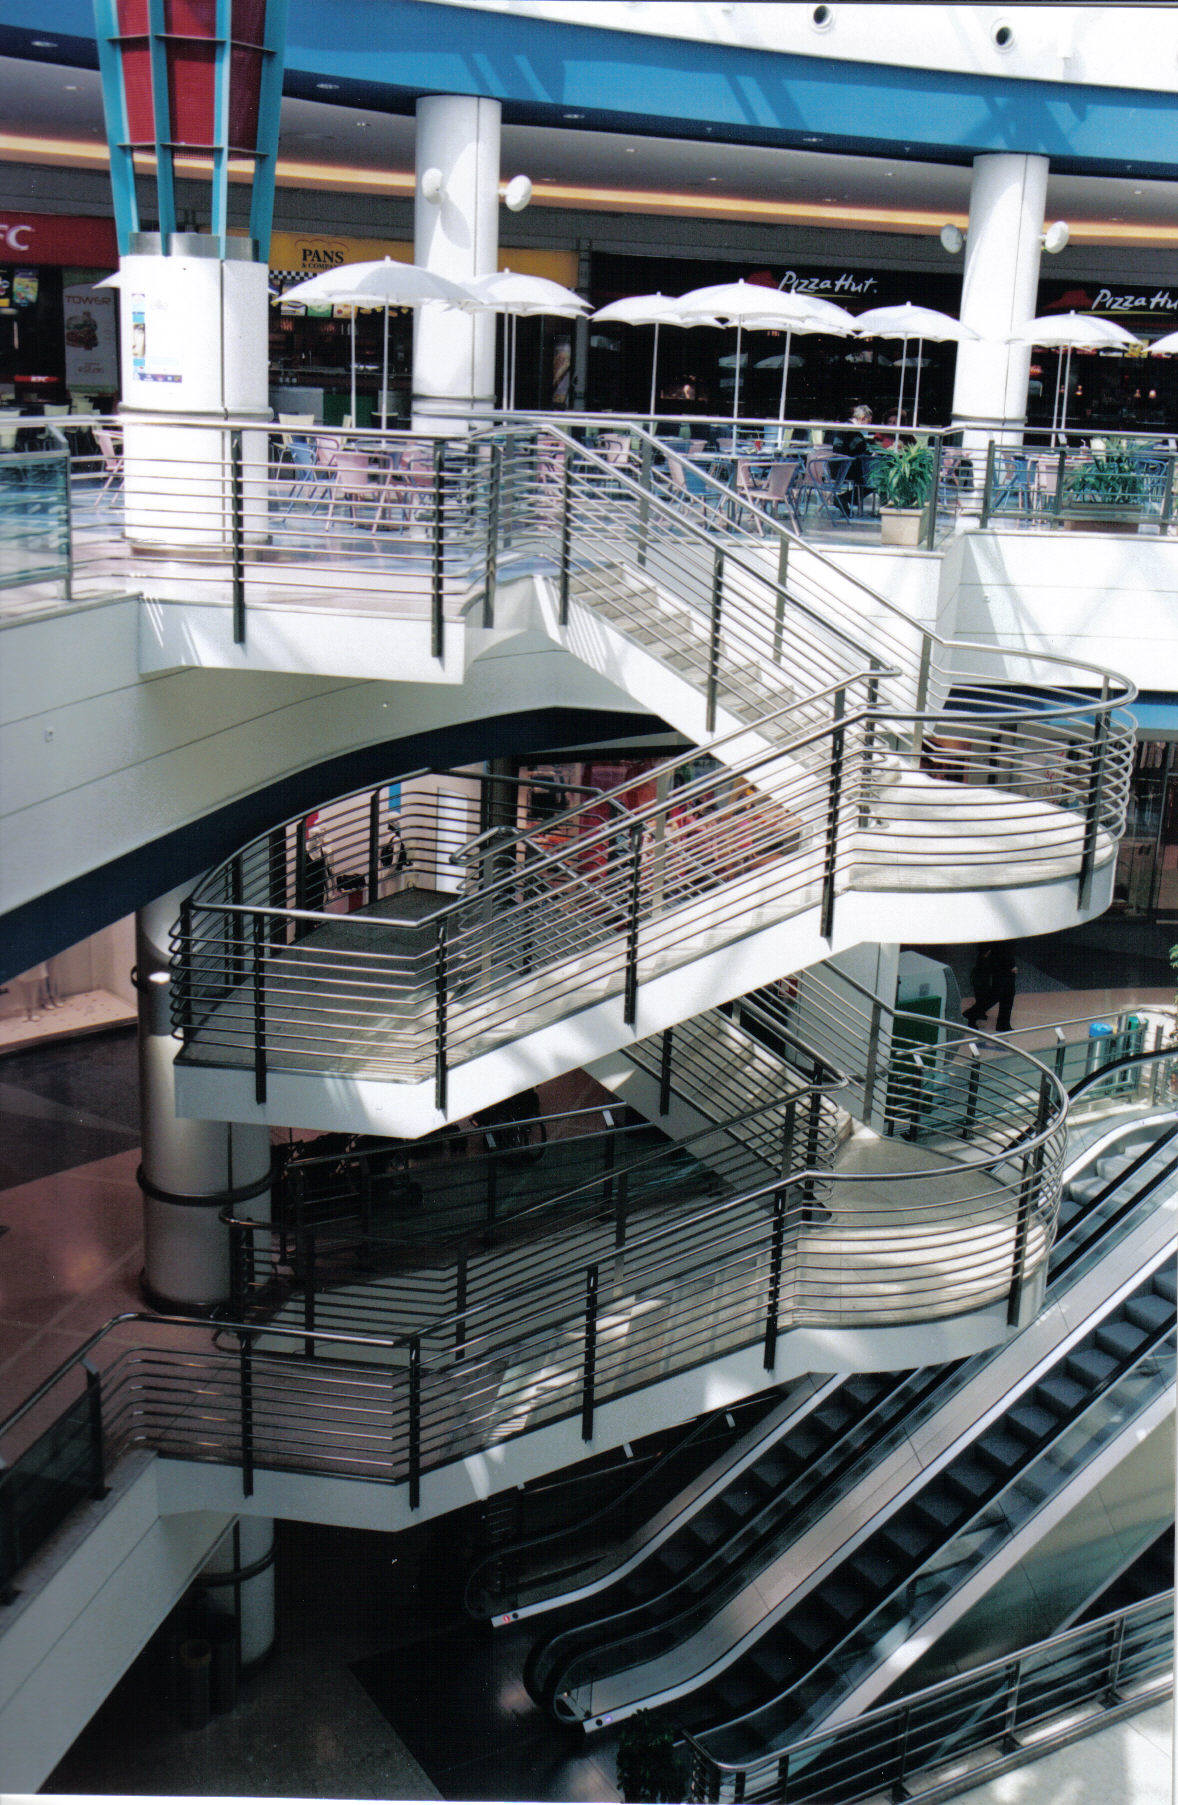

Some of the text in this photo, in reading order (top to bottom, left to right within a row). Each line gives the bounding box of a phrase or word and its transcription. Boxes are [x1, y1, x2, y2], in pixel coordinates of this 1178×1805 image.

[302, 248, 344, 264] PANS
[778, 270, 832, 293] Pizza
[65, 295, 112, 305] TOWER
[1091, 288, 1178, 310] Pizza Hu
